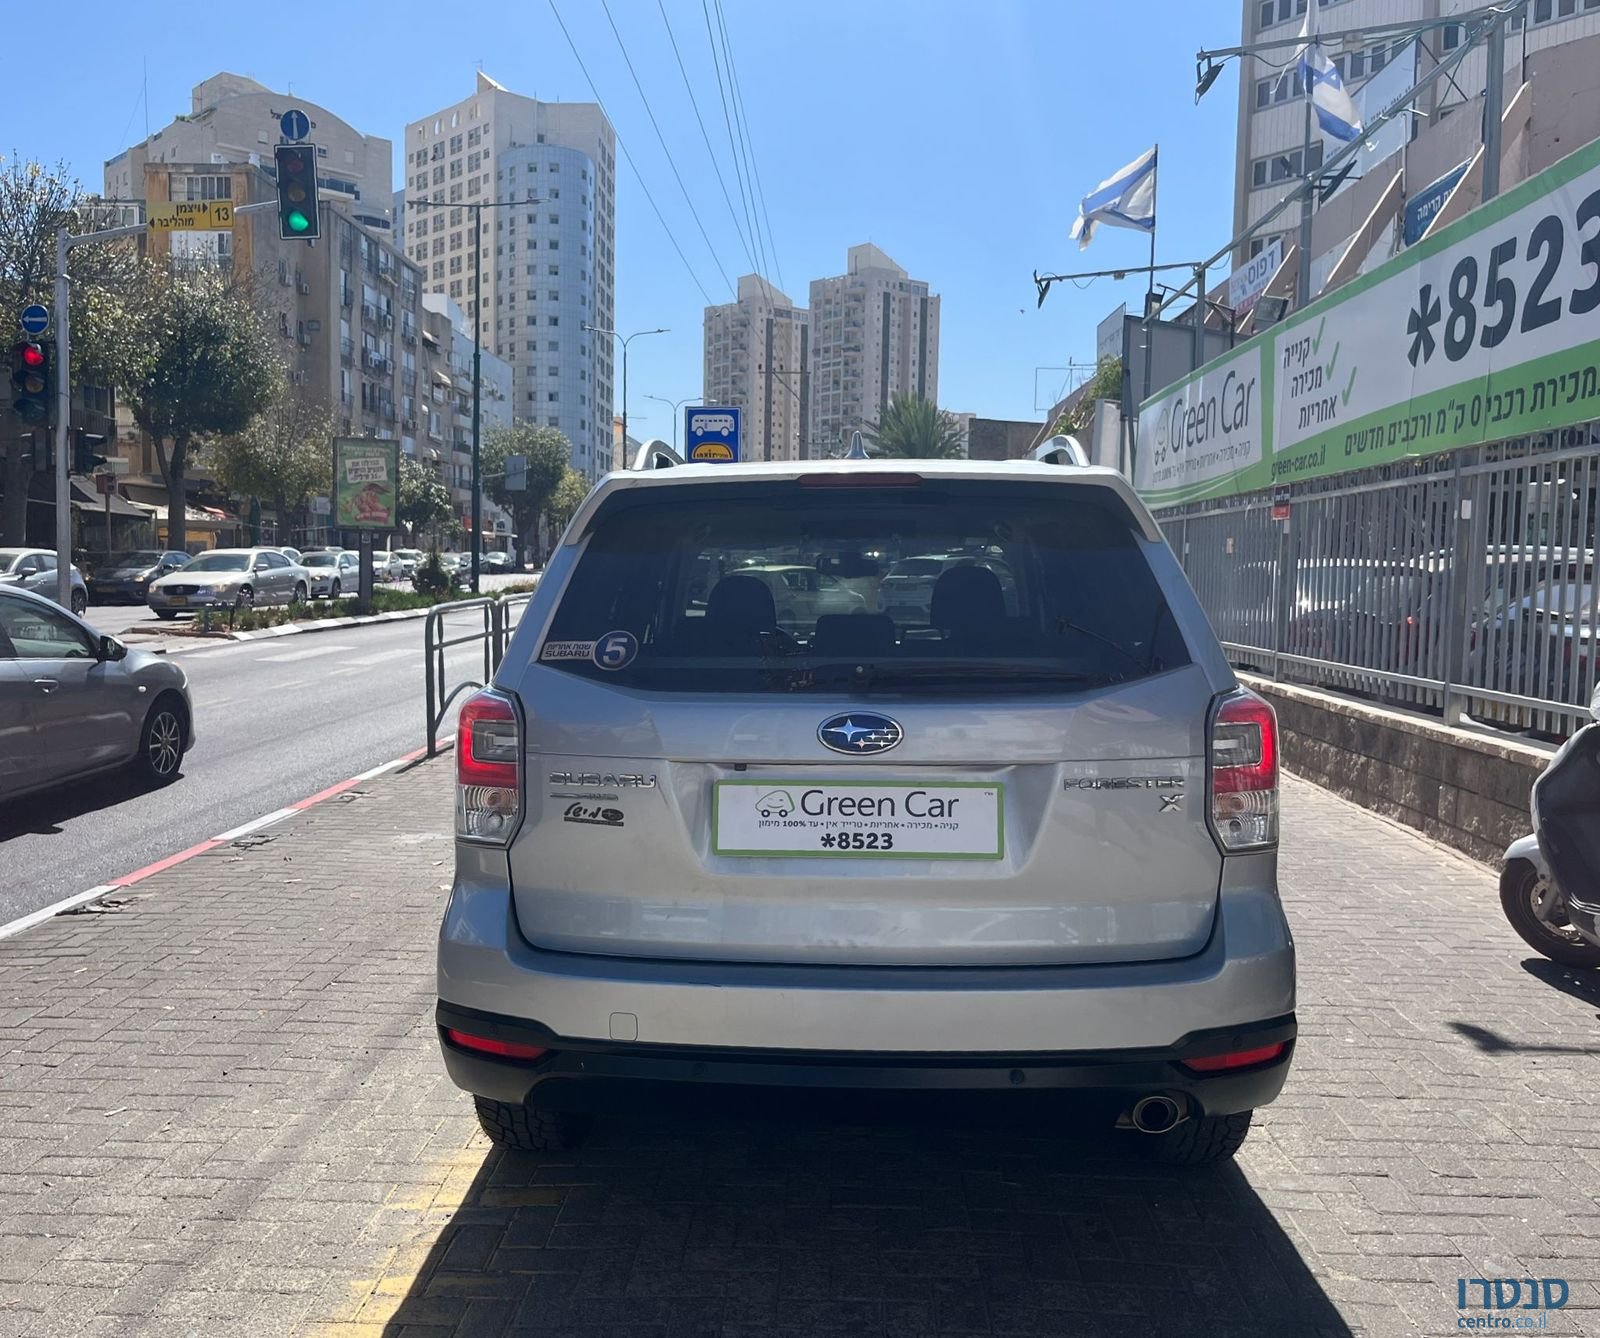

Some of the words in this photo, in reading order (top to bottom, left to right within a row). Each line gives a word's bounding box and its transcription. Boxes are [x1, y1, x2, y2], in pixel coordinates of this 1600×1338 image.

[176, 203, 201, 216] ויצמן
[214, 207, 230, 221] 13
[157, 214, 195, 227] מוהליבר
[1248, 250, 1275, 285] דפוס
[1283, 336, 1311, 369] קנייה
[1291, 365, 1323, 399] מכירה
[1530, 366, 1600, 413] מכירת
[1171, 396, 1216, 453] Green
[1221, 370, 1255, 434] Car
[1298, 395, 1338, 430] אחריות
[1387, 412, 1432, 446] ורכבים
[1344, 426, 1384, 456] חדשים
[1271, 444, 1326, 482] green-car.co.il
[545, 650, 590, 658] SUBARU
[602, 637, 628, 666] 5
[549, 771, 657, 788] SUBARU
[1063, 776, 1185, 791] FORESTER
[800, 789, 895, 817] Green
[904, 790, 960, 818] Car
[1159, 793, 1185, 812] X
[758, 820, 780, 829] מימון
[782, 820, 807, 828] 100%
[808, 820, 819, 828] עד
[825, 820, 838, 829] אין
[840, 820, 863, 829] טרייד
[869, 821, 900, 829] אחריות
[906, 821, 933, 830] מכירה
[939, 822, 959, 831] קניה
